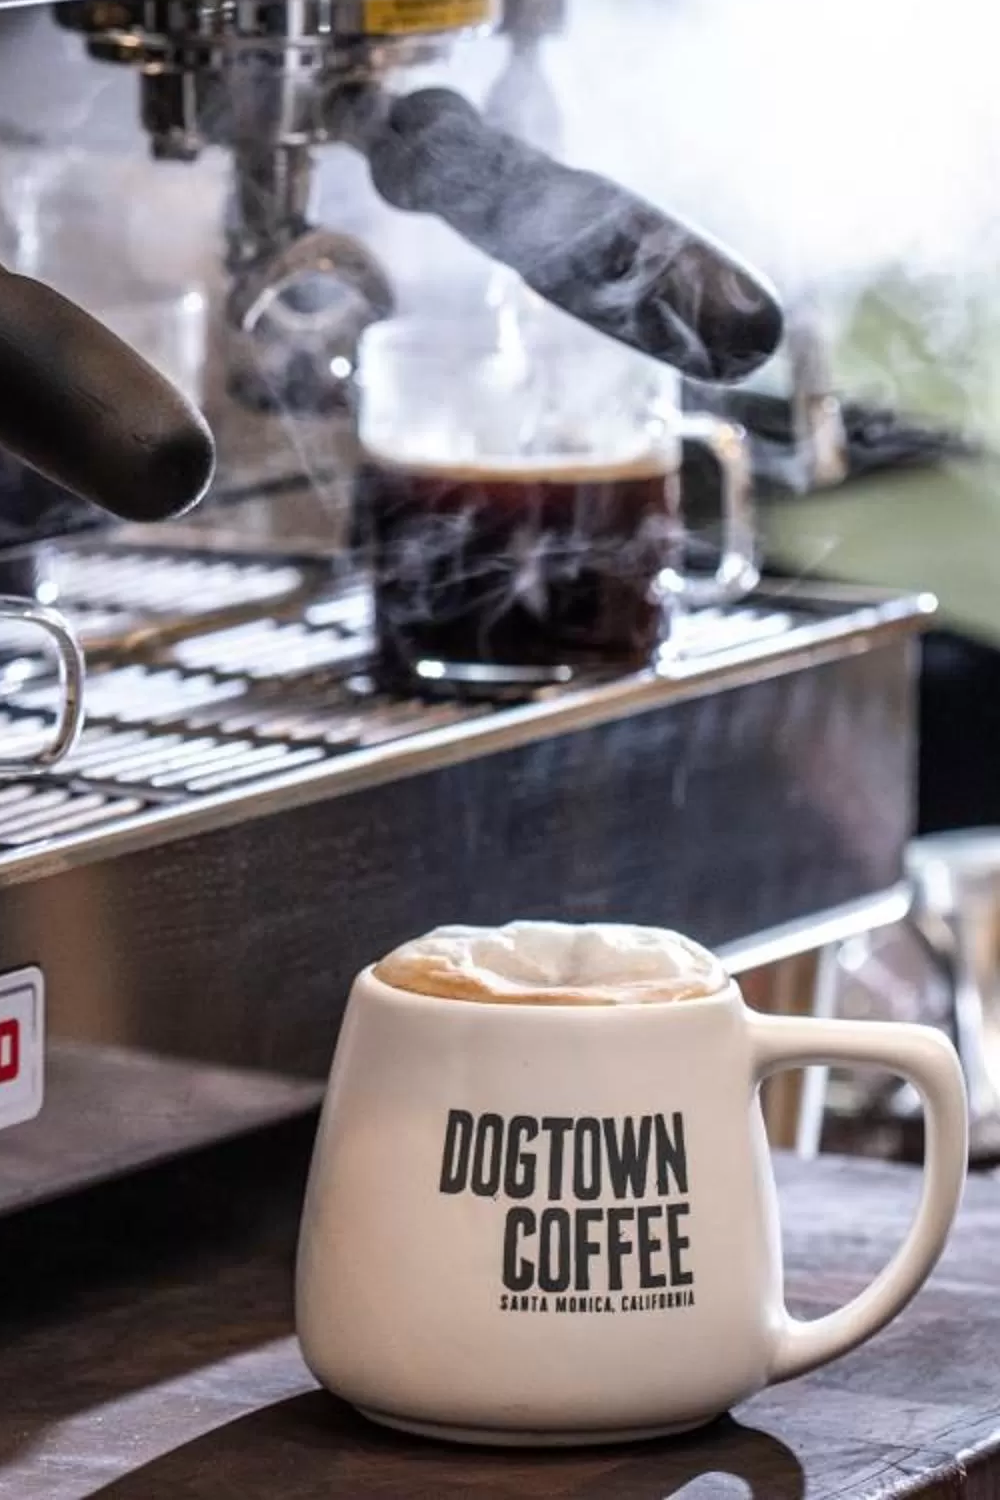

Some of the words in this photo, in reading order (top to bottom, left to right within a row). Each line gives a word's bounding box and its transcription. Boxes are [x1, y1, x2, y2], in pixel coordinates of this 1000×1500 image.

[439, 1109, 688, 1201] DOGTOWN
[502, 1202, 693, 1292] COFFEE
[500, 1295, 548, 1312] SANTA
[621, 1290, 695, 1312] CALIFORNIA
